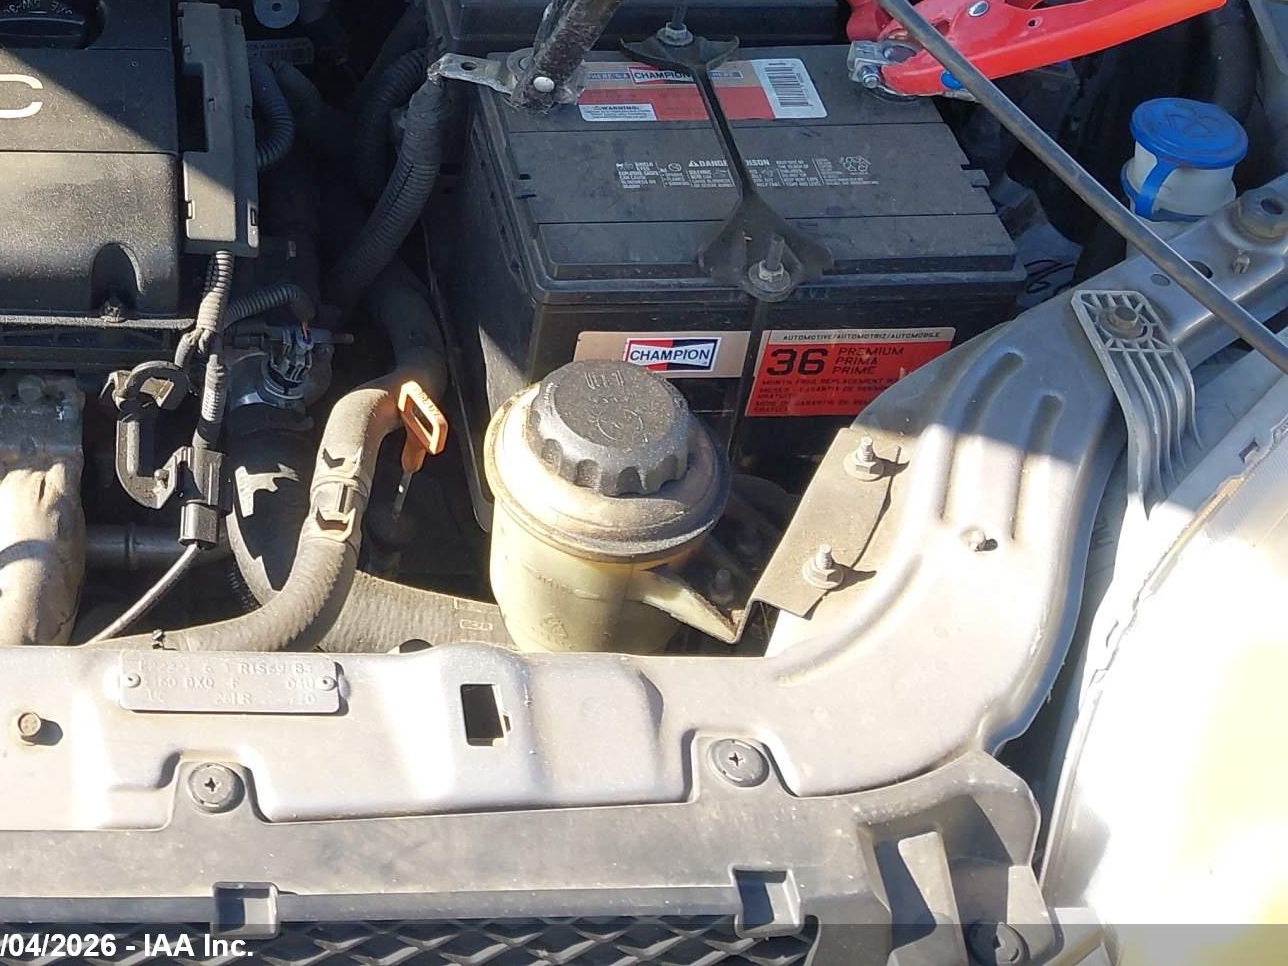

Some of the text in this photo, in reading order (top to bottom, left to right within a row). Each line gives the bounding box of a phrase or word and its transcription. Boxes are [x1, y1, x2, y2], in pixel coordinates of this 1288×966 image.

[634, 70, 694, 82] CHAMPION
[629, 349, 711, 361] CHAMPION
[838, 347, 905, 356] PREMIUM
[766, 348, 829, 376] 36
[835, 356, 879, 365] PRIMA
[832, 366, 877, 375] PRIME
